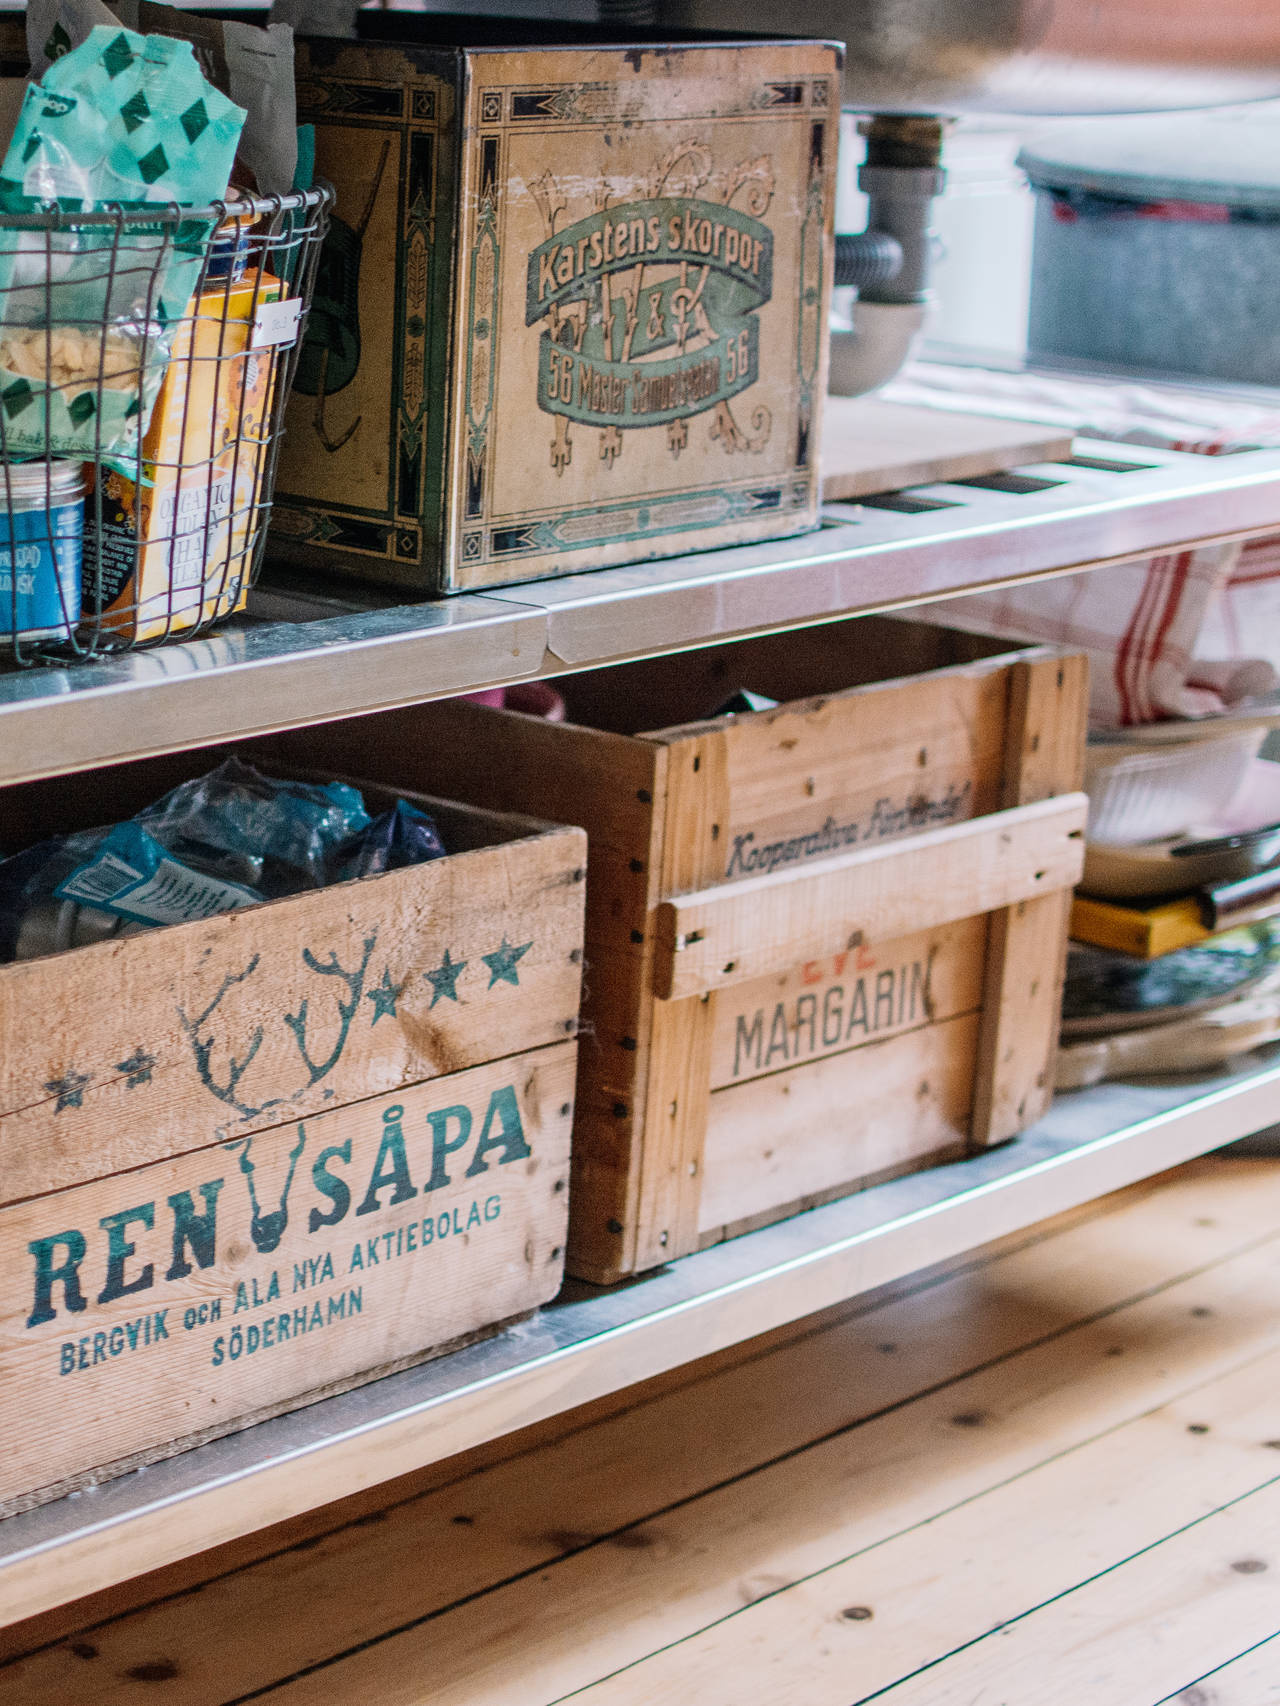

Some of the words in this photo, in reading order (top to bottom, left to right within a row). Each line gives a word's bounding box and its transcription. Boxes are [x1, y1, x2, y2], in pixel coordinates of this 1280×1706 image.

[537, 215, 660, 303] Karstens
[548, 348, 574, 404] 56
[726, 329, 749, 384] 56
[733, 957, 933, 1077] MARGARIN
[26, 1177, 224, 1329] REN
[307, 1084, 532, 1234] SÅPA
[59, 1307, 170, 1377] BERGVIK
[292, 1251, 335, 1293] NYA
[348, 1194, 503, 1275] AKTIEBOLAG
[210, 1287, 364, 1368] SÖDERHAMN
